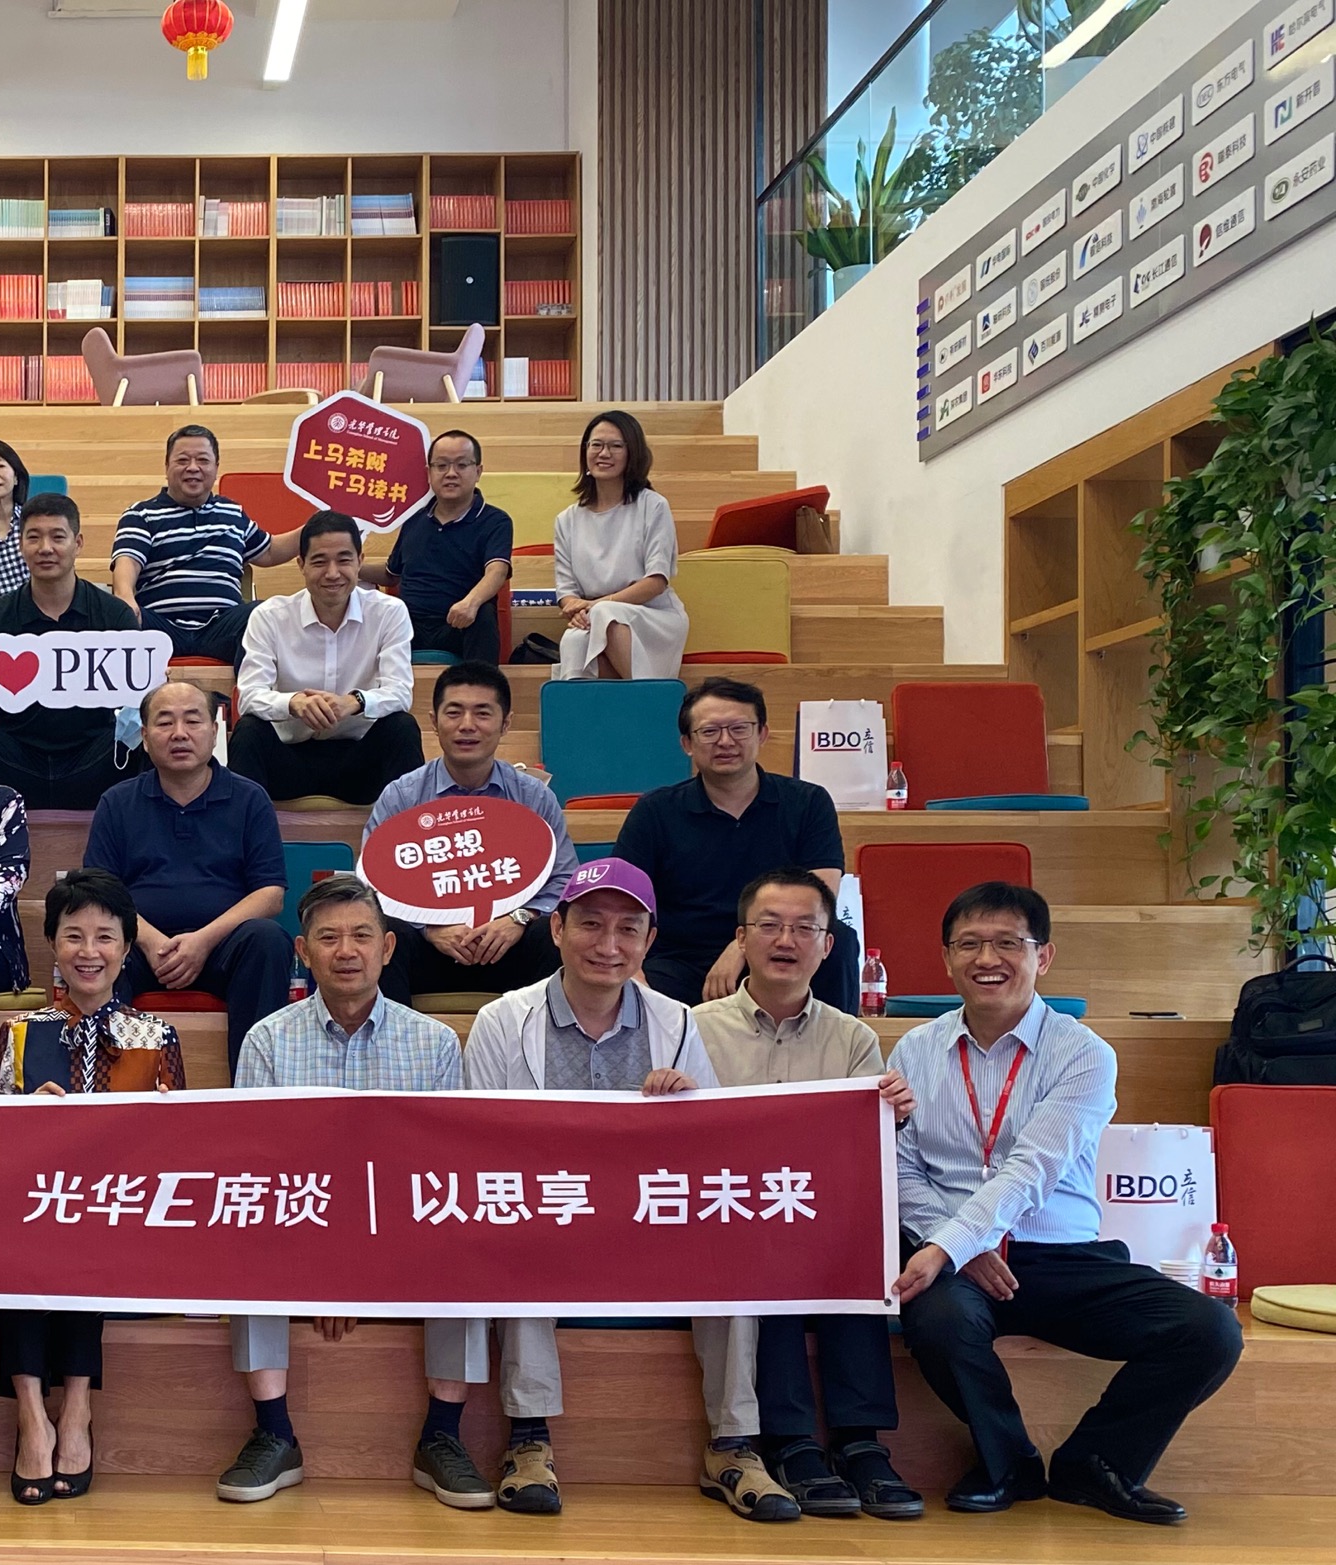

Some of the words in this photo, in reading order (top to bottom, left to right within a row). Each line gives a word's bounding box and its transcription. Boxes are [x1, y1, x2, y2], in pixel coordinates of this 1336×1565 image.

[303, 439, 388, 473] 上马杀贼
[327, 470, 408, 503] 下马读书
[52, 647, 157, 692] PKU
[817, 732, 861, 748] BDO
[863, 728, 875, 754] 立信
[395, 829, 485, 870] 因思想
[432, 856, 521, 898] 而光华
[576, 867, 601, 882] BIL
[23, 1171, 332, 1228] 光华E席谈
[411, 1170, 596, 1225] 以思享
[633, 1167, 818, 1225] 启未来
[1116, 1174, 1178, 1199] BDO
[1181, 1168, 1197, 1207] 立信
